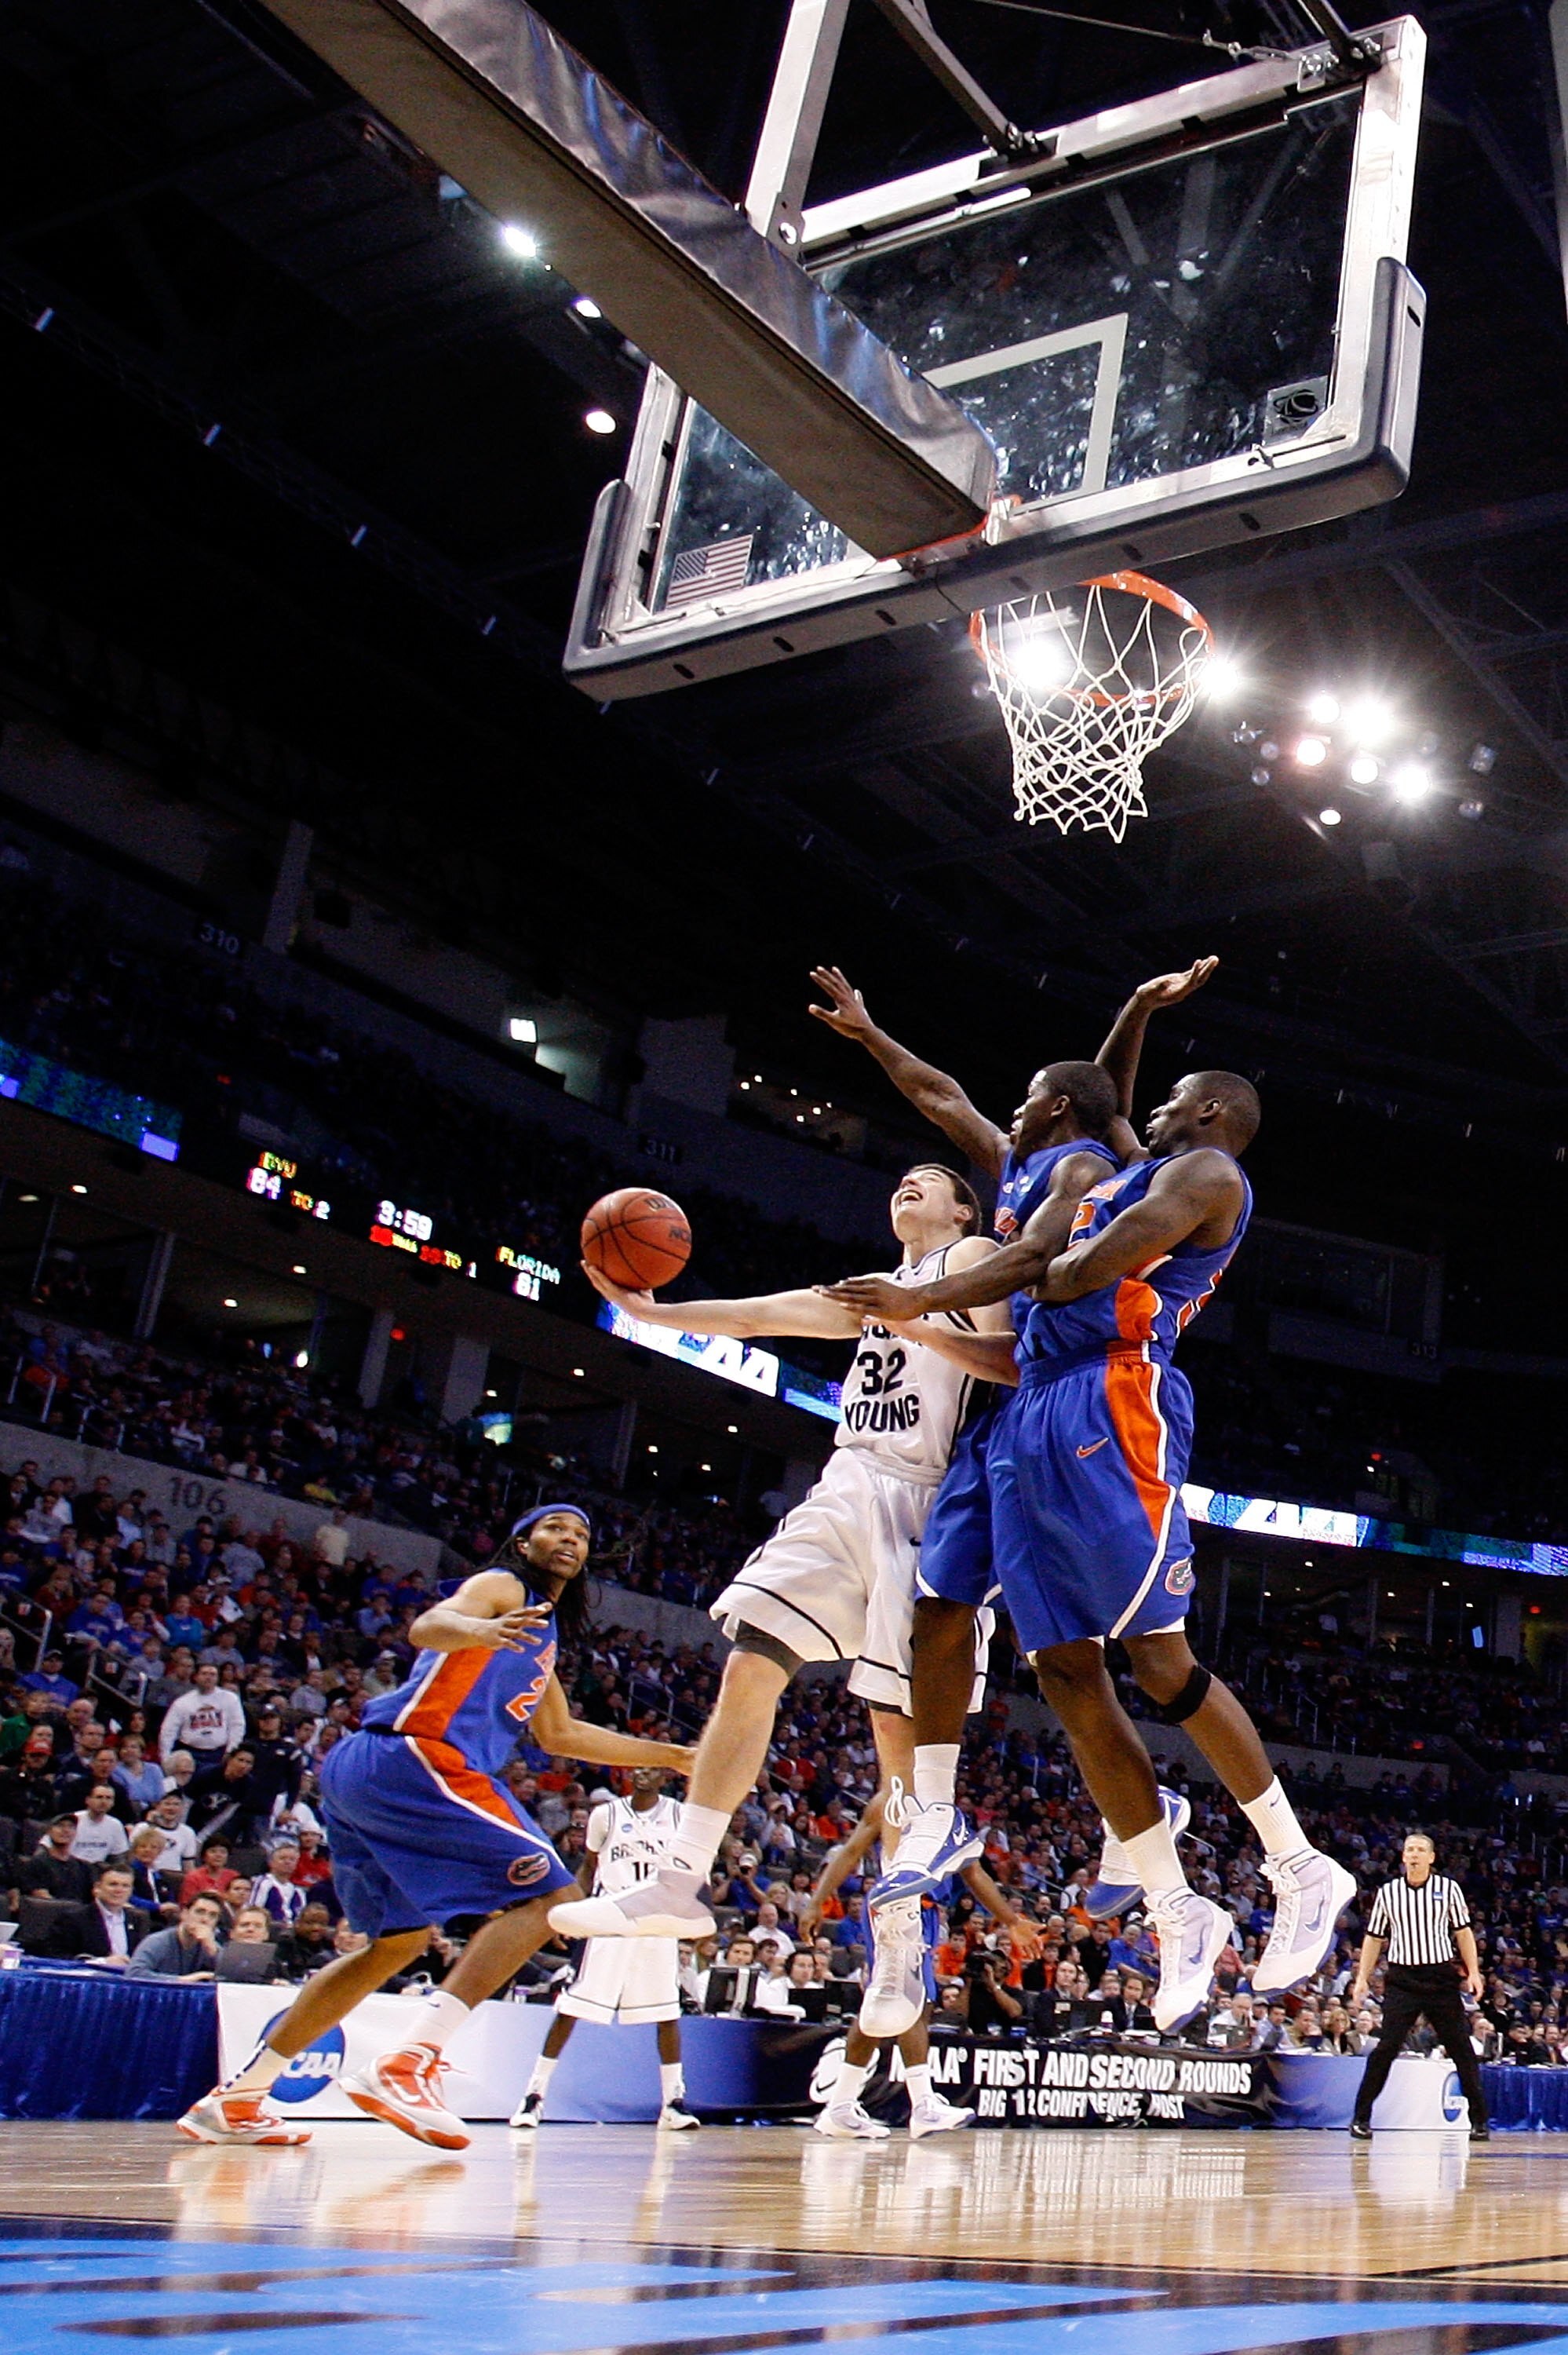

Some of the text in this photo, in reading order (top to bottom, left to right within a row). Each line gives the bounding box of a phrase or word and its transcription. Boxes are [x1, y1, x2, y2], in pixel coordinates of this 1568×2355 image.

[313, 1201, 330, 1219] 2
[377, 1200, 432, 1240] 3:59
[496, 1246, 560, 1284] FLORIDA
[857, 1348, 906, 1395] 32
[845, 1394, 920, 1434] YOUNG
[170, 1477, 226, 1513] 106
[281, 2052, 342, 2079] CAA
[974, 2047, 1040, 2087] FIRST
[1041, 2051, 1089, 2088] AND
[1089, 2054, 1176, 2091] SECOND
[1178, 2060, 1252, 2094] ROUNDS
[978, 2089, 1007, 2118] BIG
[1012, 2089, 1036, 2117] 12
[1146, 2094, 1185, 2120] HOST
